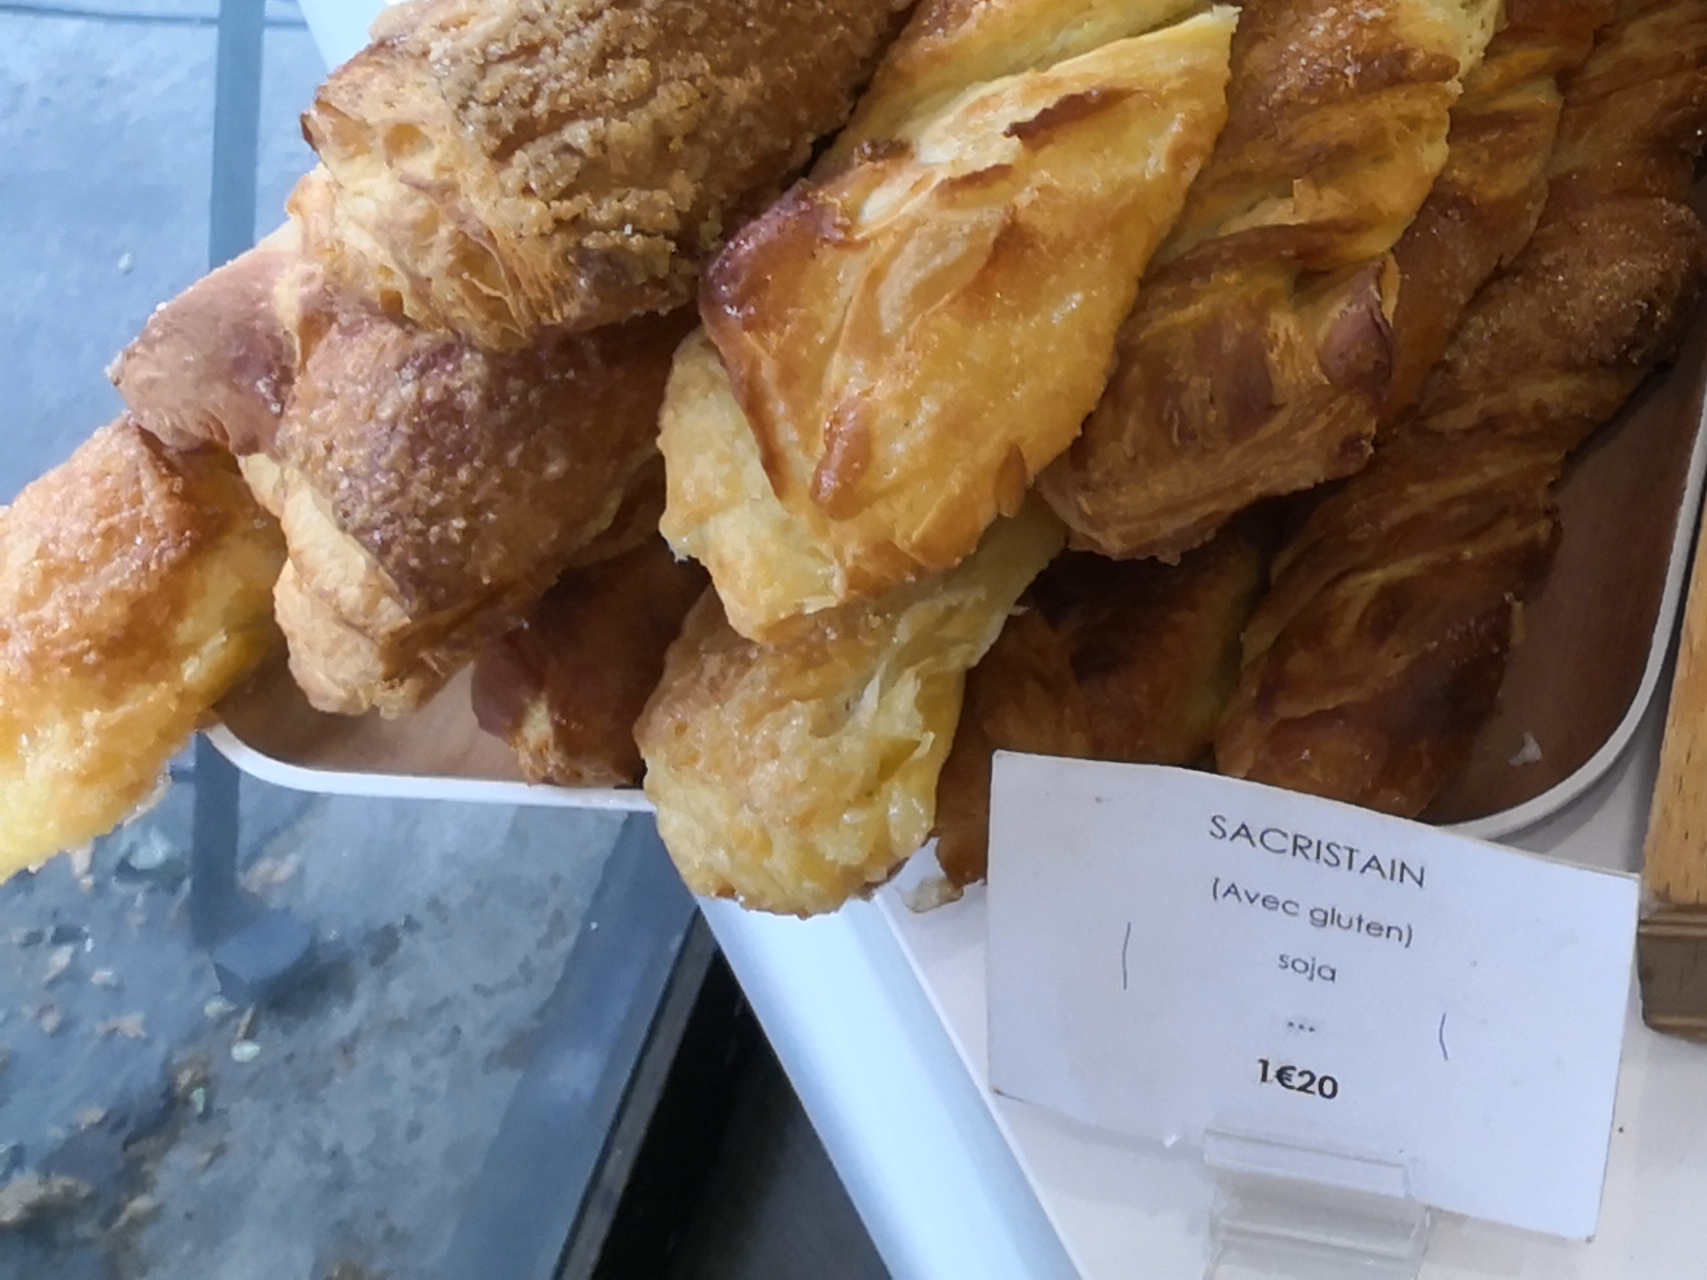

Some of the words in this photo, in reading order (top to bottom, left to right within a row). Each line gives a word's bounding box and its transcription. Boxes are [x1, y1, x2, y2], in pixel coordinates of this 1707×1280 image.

[1208, 813, 1426, 889] SACRISTAIN
[1210, 876, 1300, 918] (Avec
[1309, 904, 1414, 948] gluten)
[1277, 951, 1337, 984] soja
[1256, 1057, 1339, 1100] 1€20
